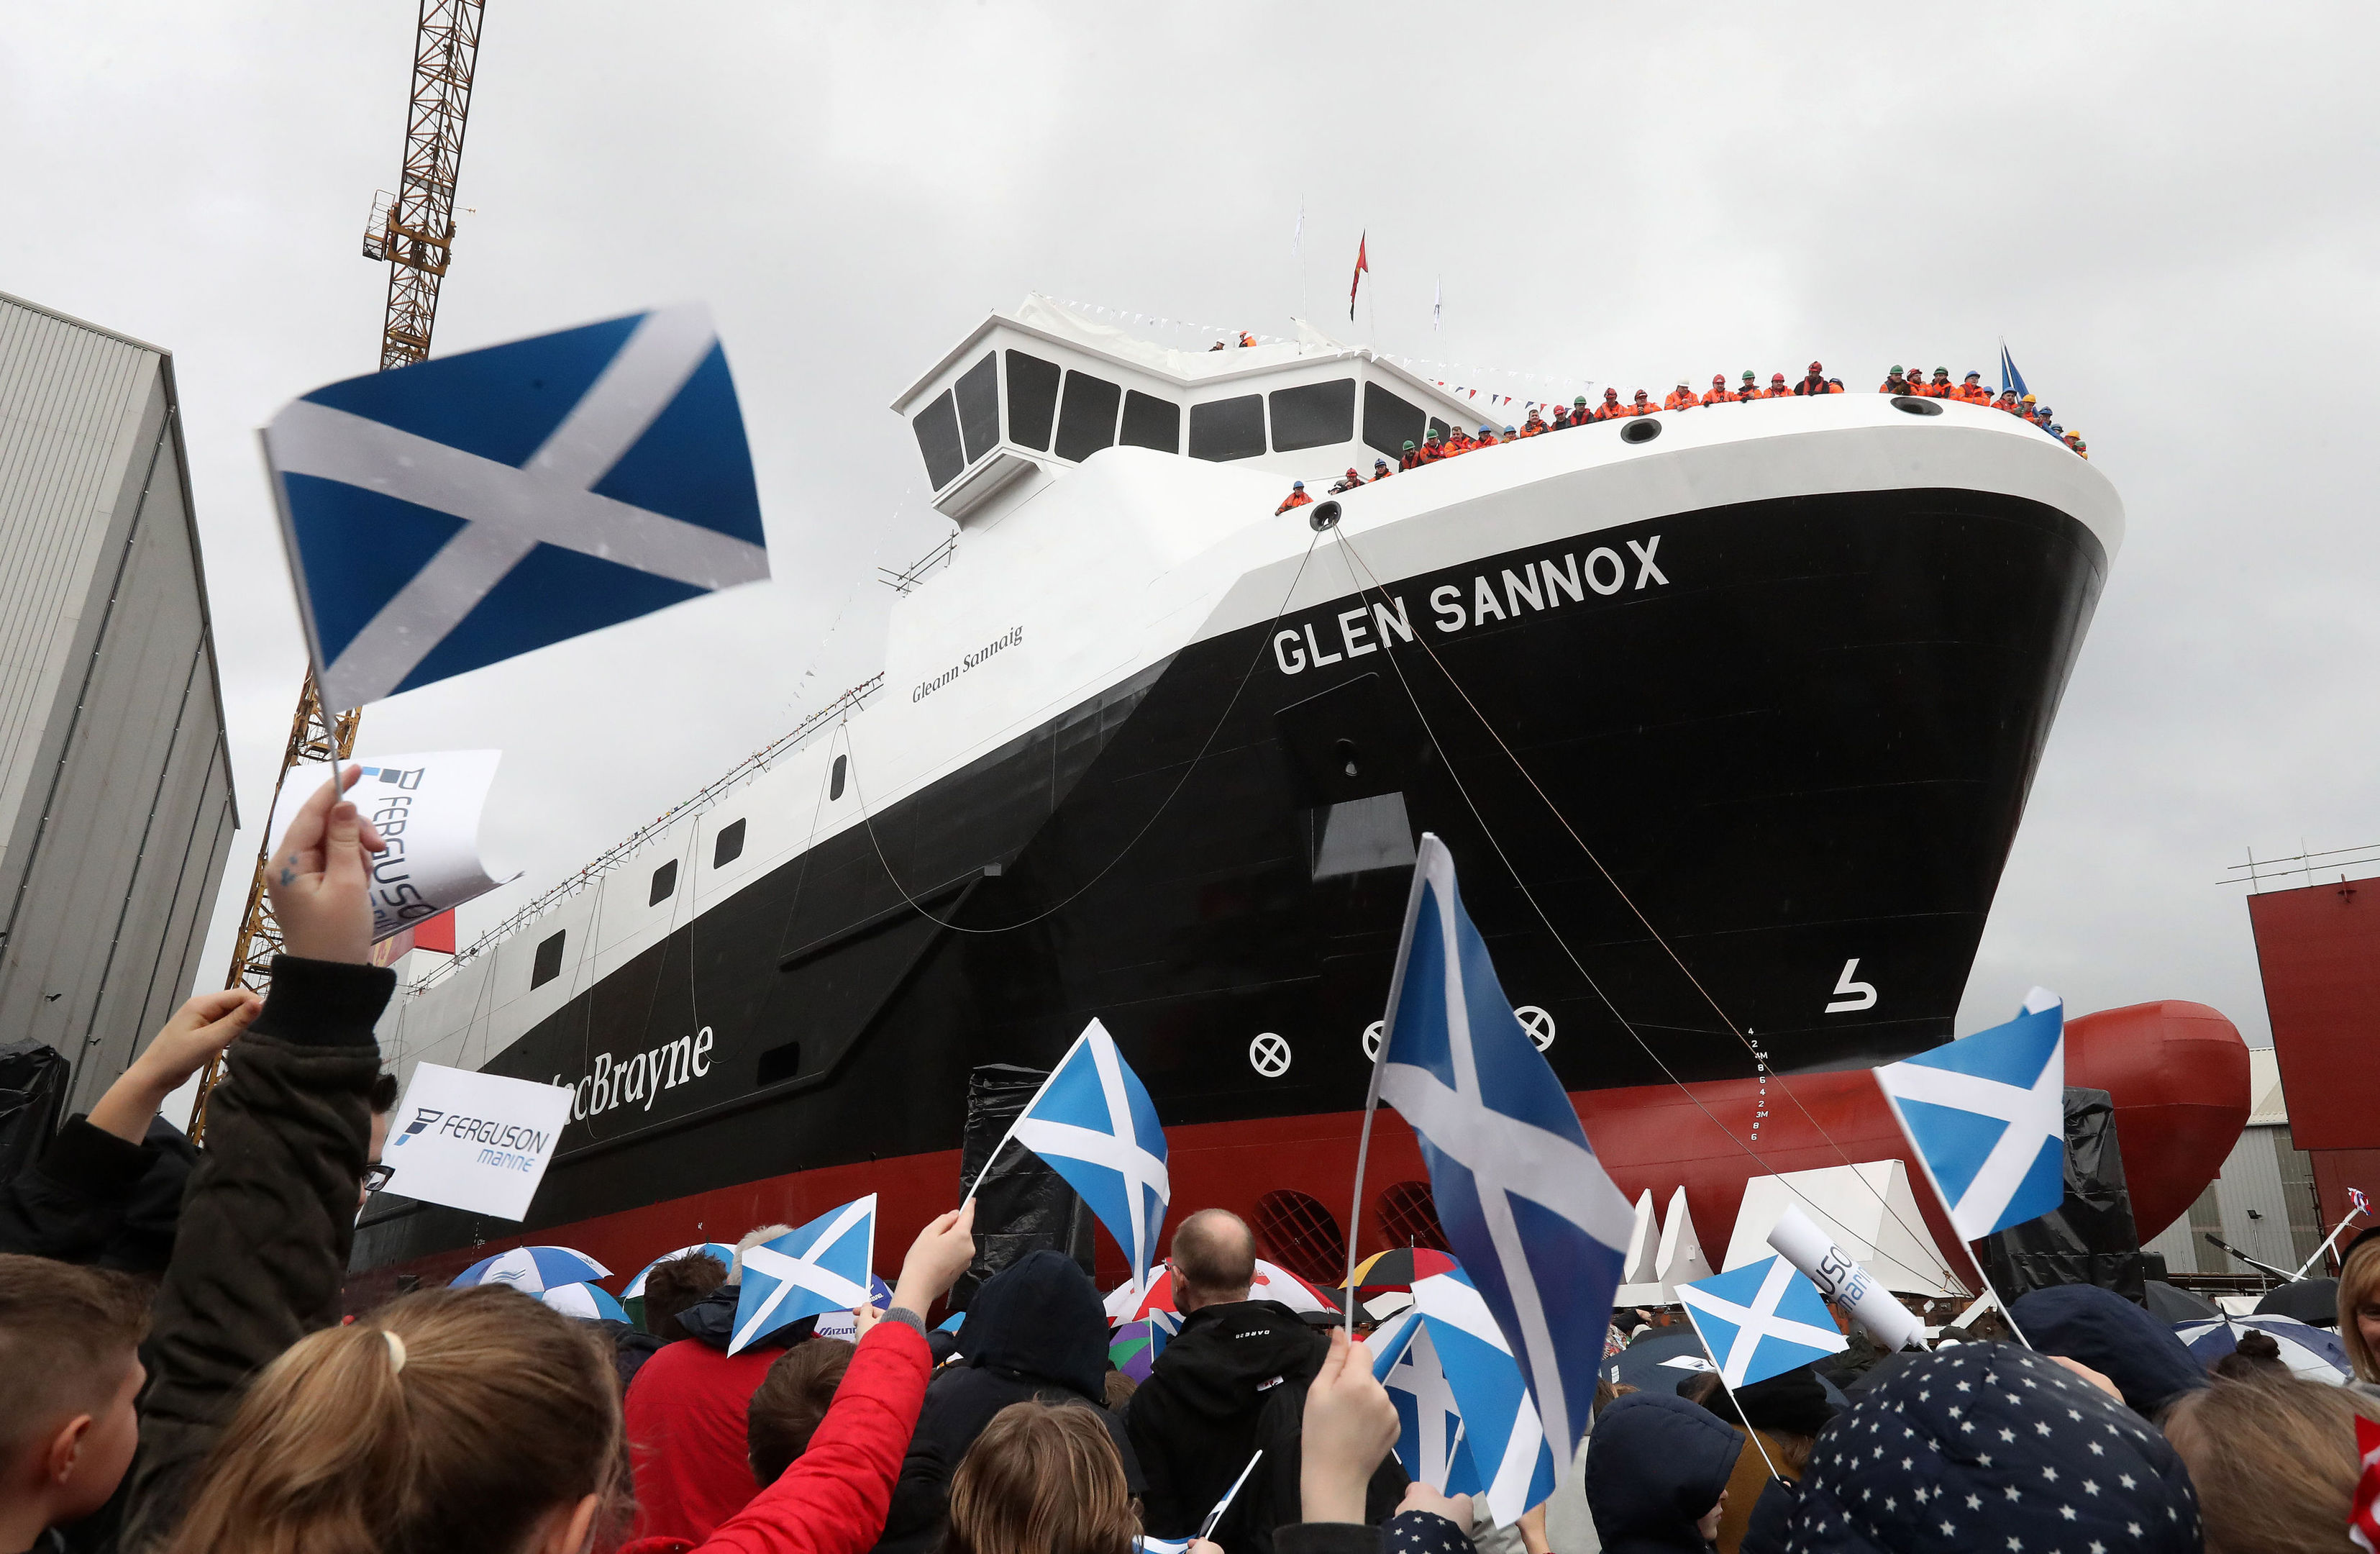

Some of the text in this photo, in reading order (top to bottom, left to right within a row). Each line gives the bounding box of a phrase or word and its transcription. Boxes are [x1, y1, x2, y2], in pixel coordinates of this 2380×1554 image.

[1273, 535, 1669, 675] GLEN SANNOX
[912, 625, 1023, 703] Gleann Sannaig
[373, 796, 437, 919] FERGUSO
[552, 1025, 713, 1125] cBrayne
[439, 1115, 550, 1154] FERGUSON
[477, 1148, 535, 1173] marine
[1812, 1242, 1854, 1295] USO
